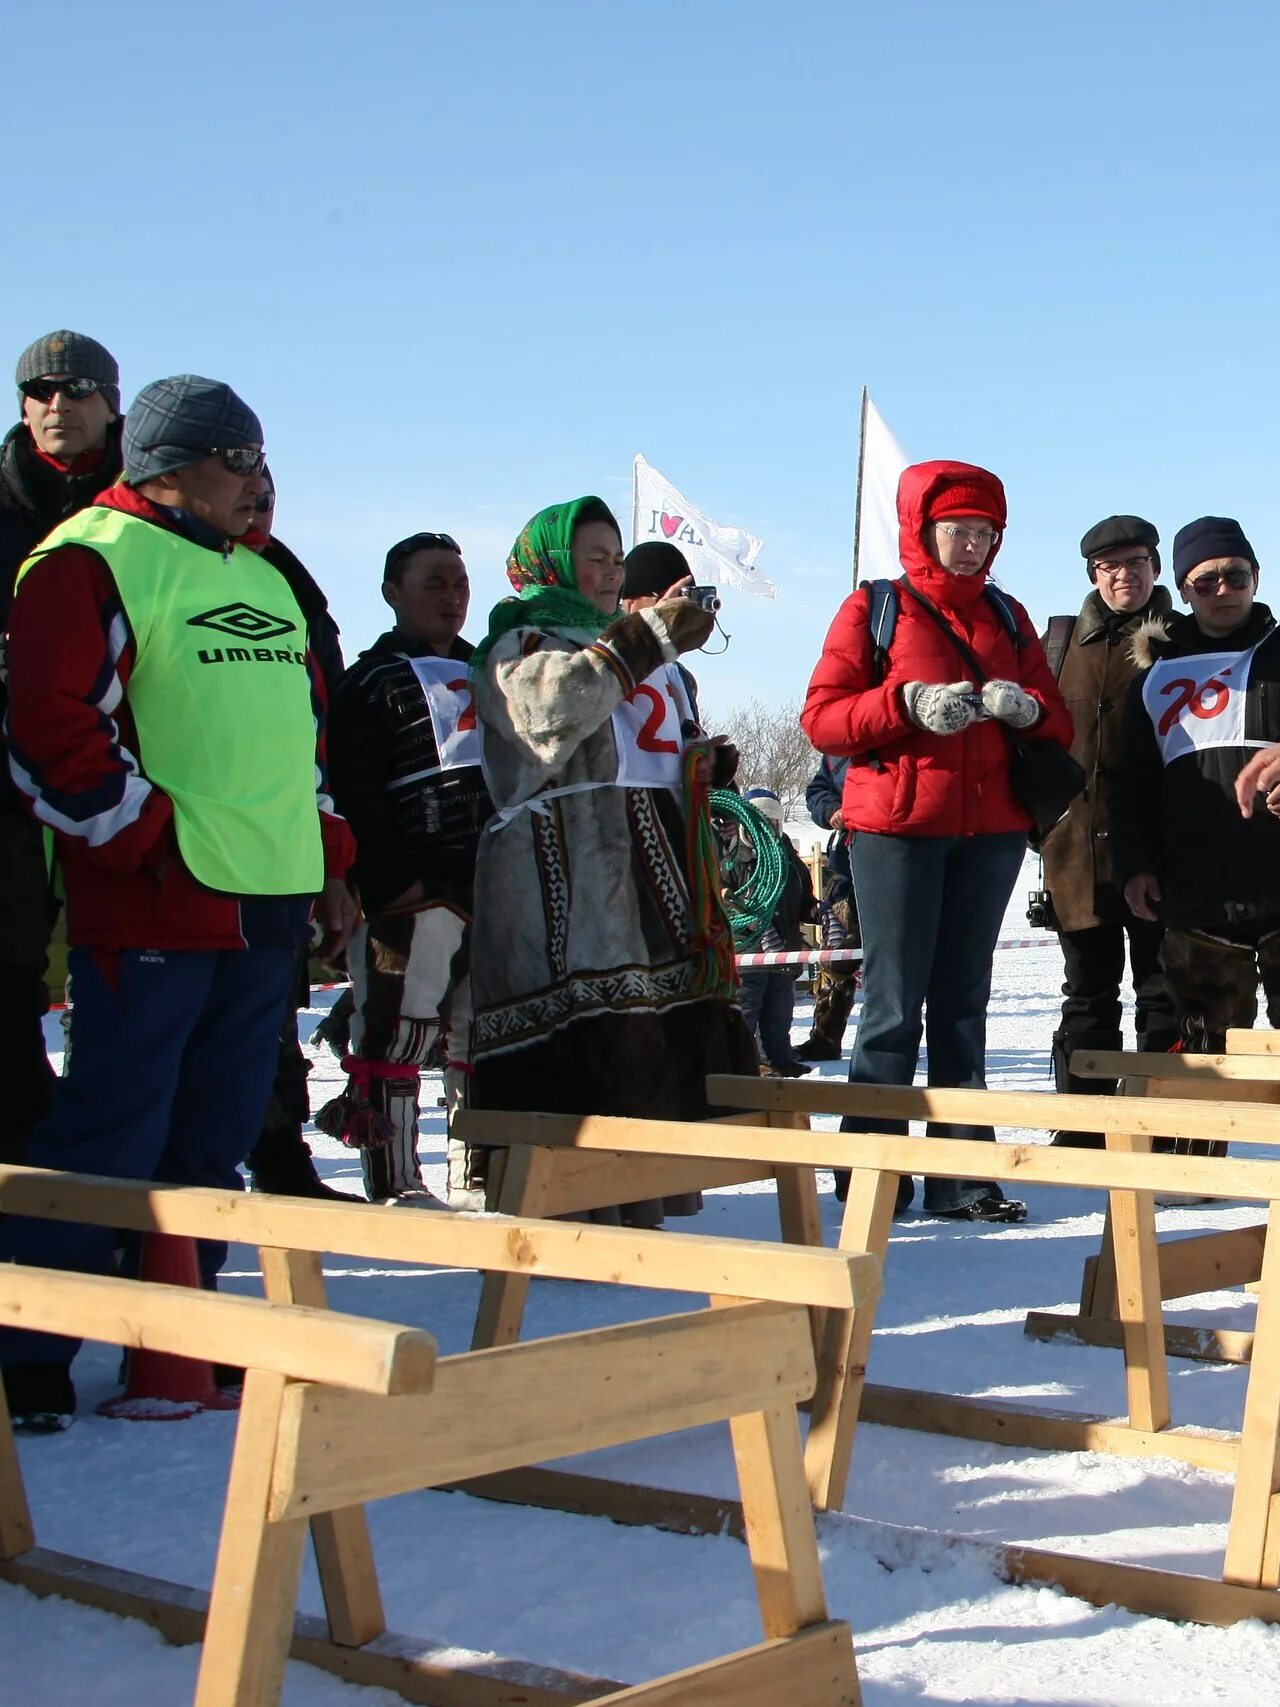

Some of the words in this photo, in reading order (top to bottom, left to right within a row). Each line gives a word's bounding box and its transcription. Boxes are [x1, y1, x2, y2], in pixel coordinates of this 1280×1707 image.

[197, 648, 308, 666] UMBRO
[623, 683, 679, 754] 2
[1158, 667, 1232, 737] 26
